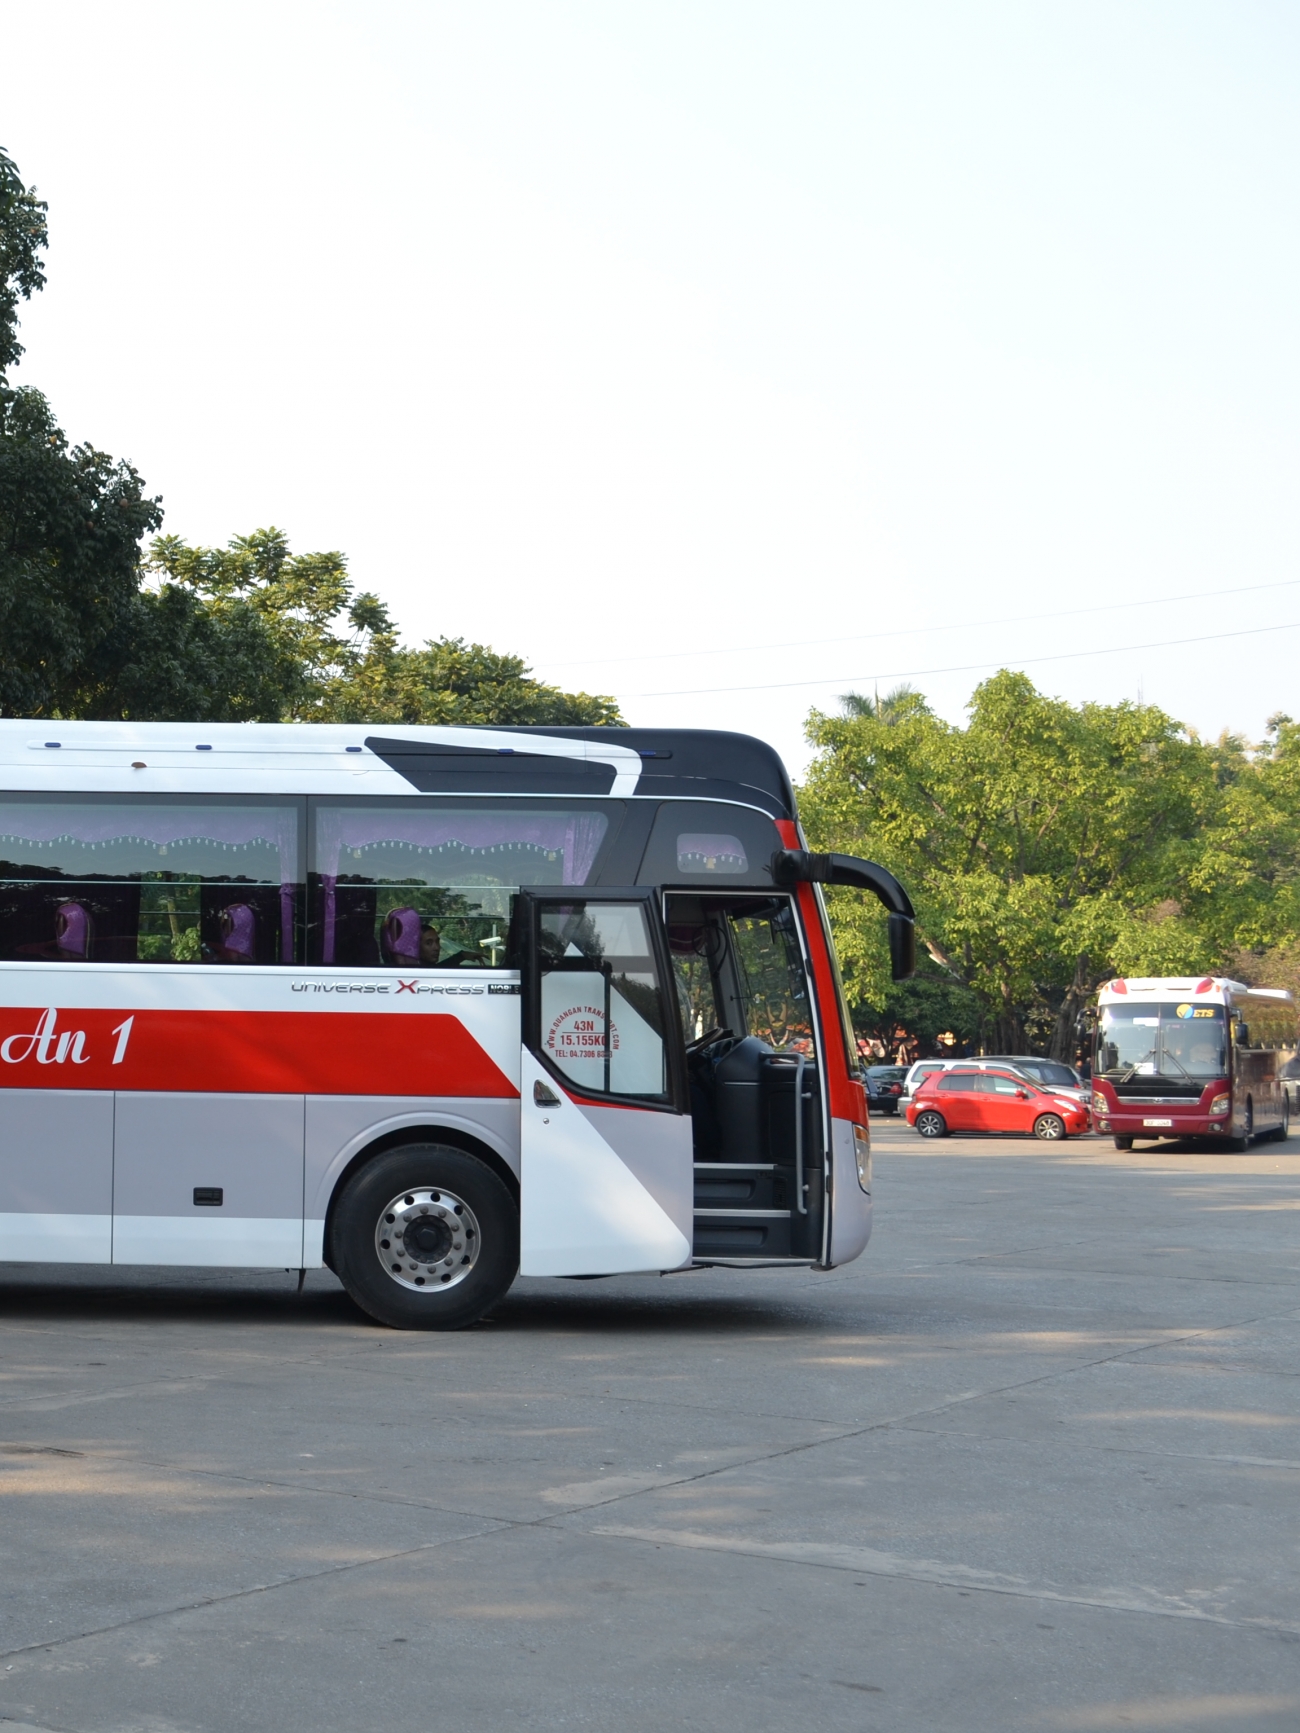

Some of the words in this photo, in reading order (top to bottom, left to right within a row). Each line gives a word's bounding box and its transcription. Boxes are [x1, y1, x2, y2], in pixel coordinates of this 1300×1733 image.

[291, 980, 391, 994] UNIVERSE
[573, 1020, 594, 1032] 43N
[0, 1006, 90, 1065] An
[111, 1014, 135, 1065] 1
[555, 1049, 568, 1057] TEL:
